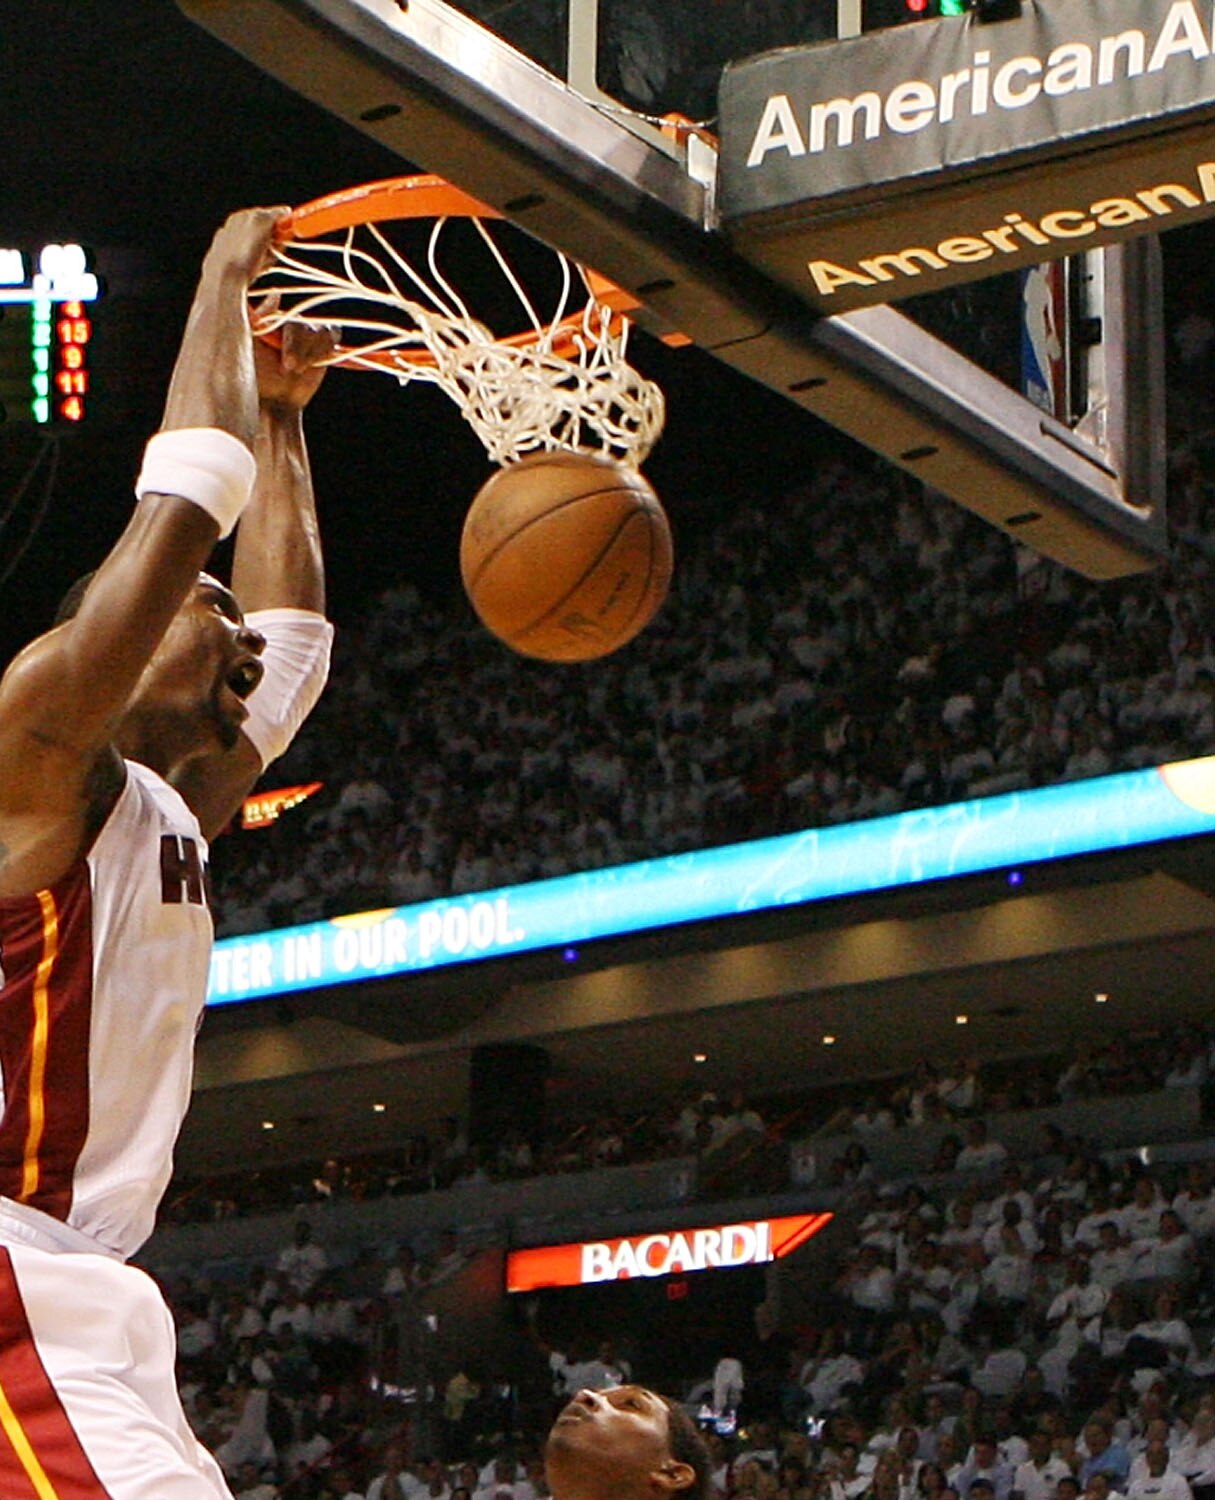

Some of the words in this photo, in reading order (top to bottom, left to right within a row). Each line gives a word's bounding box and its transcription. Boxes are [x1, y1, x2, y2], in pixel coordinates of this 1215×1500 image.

[746, 0, 1215, 168] AmericanA
[60, 320, 90, 345] 15
[58, 371, 87, 395] 11
[63, 396, 82, 421] 4
[210, 940, 273, 995] TER
[283, 931, 322, 982] IN
[333, 917, 407, 972] OUR
